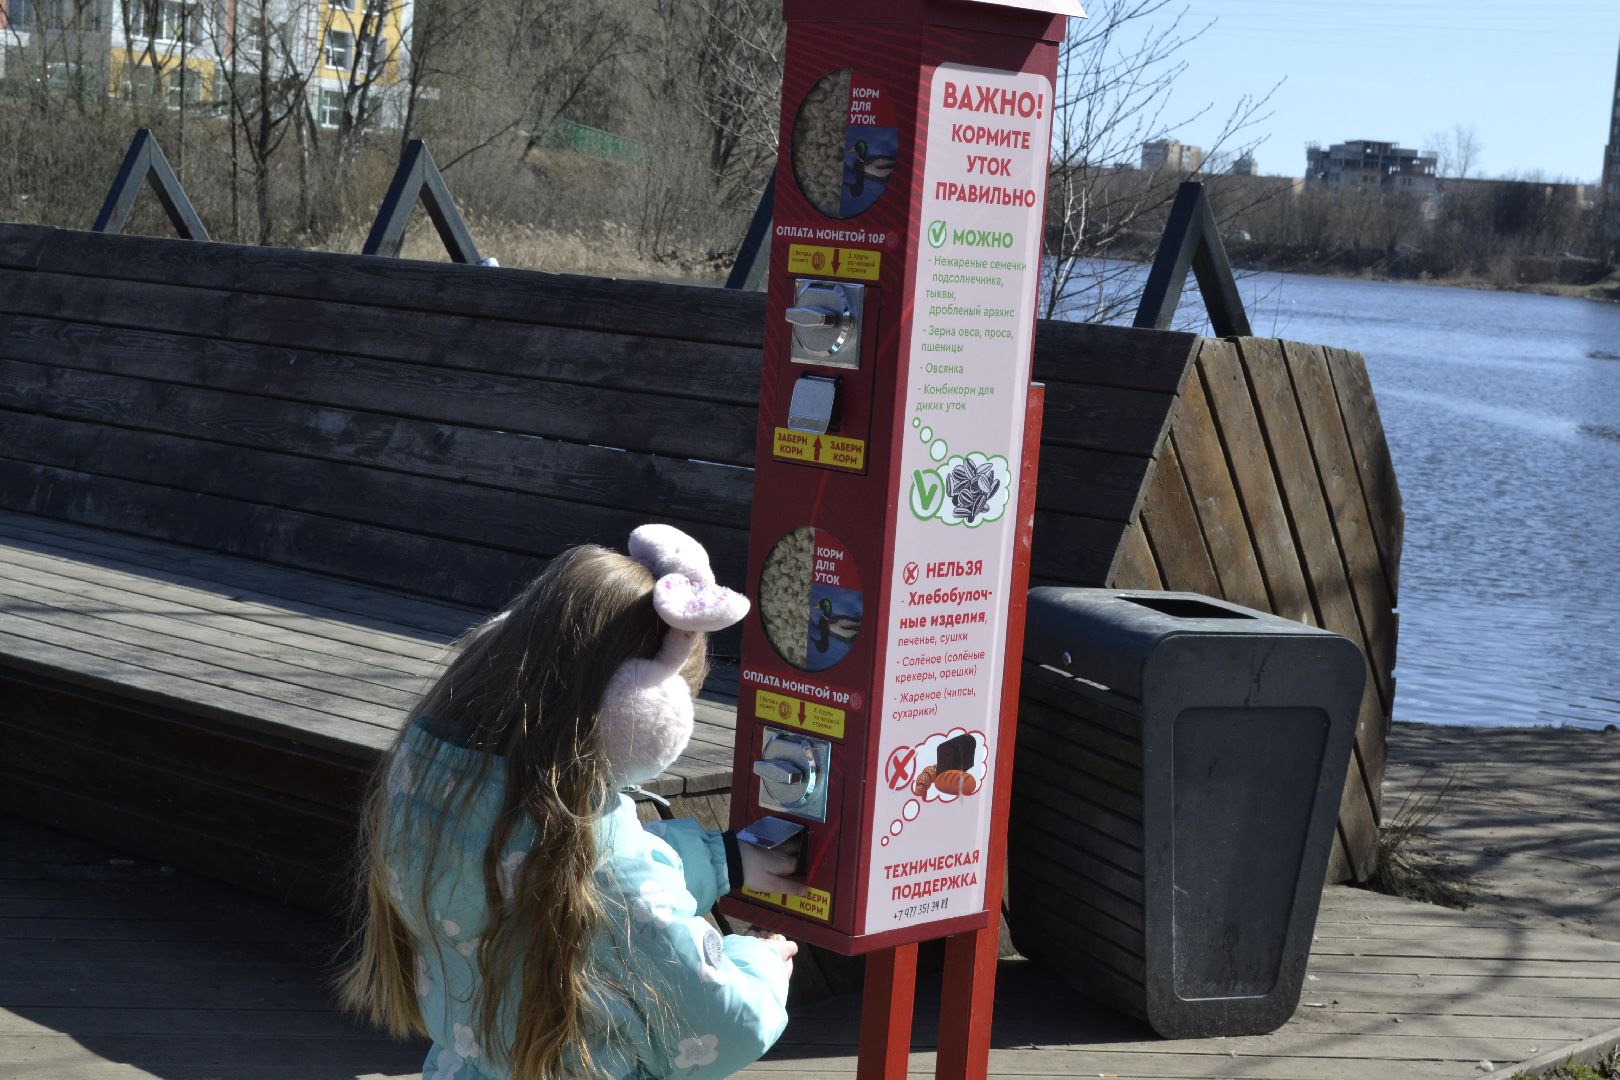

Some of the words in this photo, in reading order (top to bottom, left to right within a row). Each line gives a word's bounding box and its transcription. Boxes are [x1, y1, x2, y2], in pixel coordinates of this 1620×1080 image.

[852, 87, 880, 98] КОРМ
[943, 81, 1044, 119] ВАЖНО!
[850, 101, 871, 112] ДЛЯ
[850, 114, 876, 125] УТОК
[951, 123, 1031, 150] КОРМИТЕ
[966, 154, 1012, 177] УТОК
[935, 181, 1036, 208] ПРАВИЛЬНО
[776, 225, 814, 239] ОПЛАТА
[816, 228, 865, 243] МОНЕТОЙ
[952, 228, 1014, 249] МОЖНО
[934, 255, 988, 270] Нежареные
[989, 260, 1027, 272] семечки
[932, 273, 1004, 287] подсолнечника,
[926, 289, 956, 302] тыквы,
[929, 303, 981, 317] дробленый
[983, 308, 1015, 319] арахис
[928, 325, 956, 339] Зерна
[958, 329, 982, 339] овса,
[984, 329, 1014, 341] проса,
[921, 343, 964, 355] пшеницы
[925, 362, 964, 374] Овсянка
[923, 383, 976, 397] Комбикорм
[977, 387, 995, 397] для
[915, 401, 943, 413] диких
[946, 401, 966, 414] уток
[777, 432, 808, 446] ЗАБЕРИ
[780, 444, 803, 456] КОРМ
[830, 441, 862, 454] ЗАБЕРИ
[833, 452, 857, 465] КОРМ
[817, 547, 844, 561] КОРМ
[815, 560, 835, 572] ДЛЯ
[926, 560, 983, 579] НЕЛЬЗЯ
[815, 572, 840, 586] УТОК
[908, 586, 993, 607] Хлебобулоч-
[899, 616, 927, 630] ные
[930, 611, 988, 629] изделия,
[898, 635, 938, 647] печенье,
[940, 632, 969, 645] сушки
[902, 653, 942, 667] Солёное
[944, 650, 985, 665] (солёные
[895, 671, 937, 685] крекеры,
[939, 665, 977, 680] орешки)
[743, 669, 781, 688] ОПЛАТА
[782, 679, 830, 700] МОНЕТОЙ
[899, 690, 942, 704] Жареное
[943, 687, 976, 700] (чипсы,
[892, 703, 938, 722] сухарики)
[884, 849, 980, 880] ТЕХНИЧЕСКАЯ
[891, 872, 978, 901] ПОДДЕРЖКА
[801, 891, 828, 905] БЕРИ
[800, 901, 824, 916] КОРМ
[918, 903, 930, 915] 351
